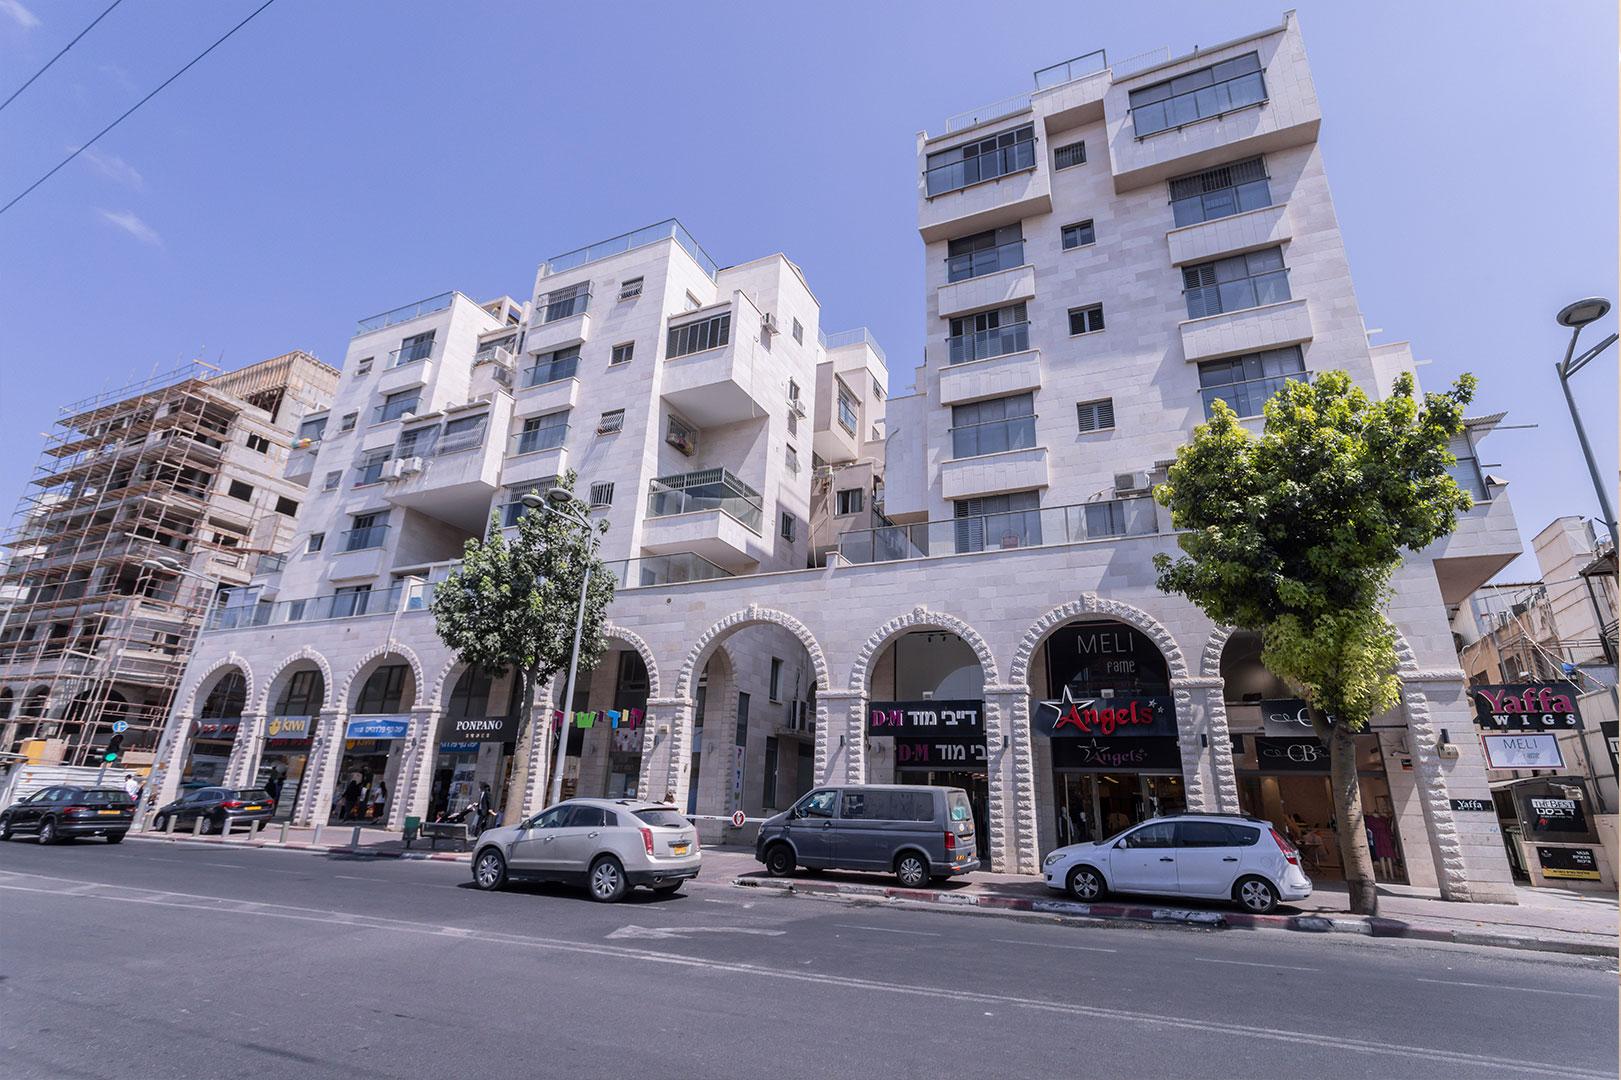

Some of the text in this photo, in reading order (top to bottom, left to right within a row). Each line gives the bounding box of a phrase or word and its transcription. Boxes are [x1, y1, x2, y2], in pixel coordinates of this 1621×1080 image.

[1077, 632, 1134, 654] MELI
[1477, 687, 1576, 714] Yaffa
[456, 720, 503, 731] PONPANO
[907, 710, 937, 726] מוד
[941, 710, 977, 725] דייבי
[1056, 701, 1154, 735] Angels
[1492, 714, 1577, 726] WIGS
[1503, 738, 1538, 749] MELI
[935, 744, 966, 760] מוד
[1092, 749, 1143, 767] Angels
[1287, 744, 1317, 762] CB
[1457, 800, 1482, 808] Yaffa
